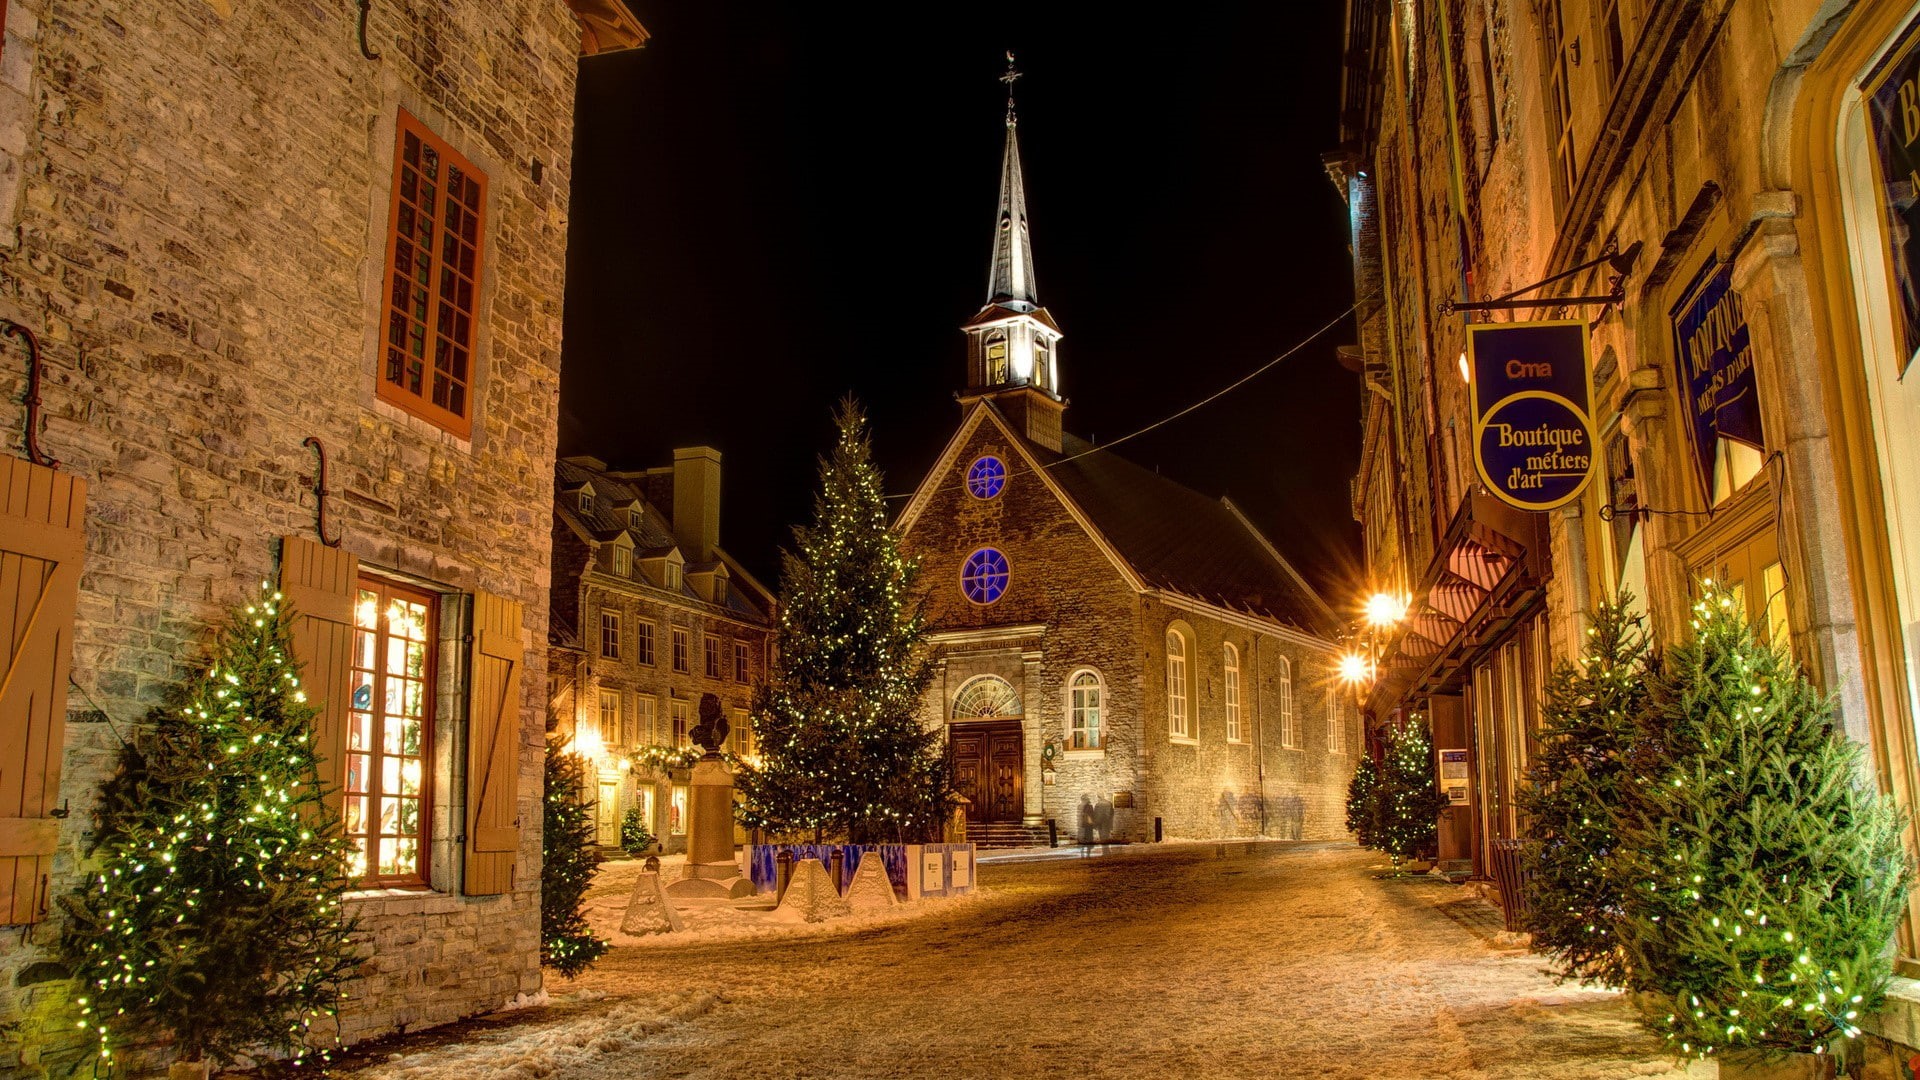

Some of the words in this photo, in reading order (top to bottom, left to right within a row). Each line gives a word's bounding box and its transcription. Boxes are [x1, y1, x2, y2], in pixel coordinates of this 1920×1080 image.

[1505, 359, 1553, 379] Cma
[1498, 423, 1583, 453] Boutique
[1526, 451, 1589, 471] métiers
[1507, 467, 1544, 489] d'art
